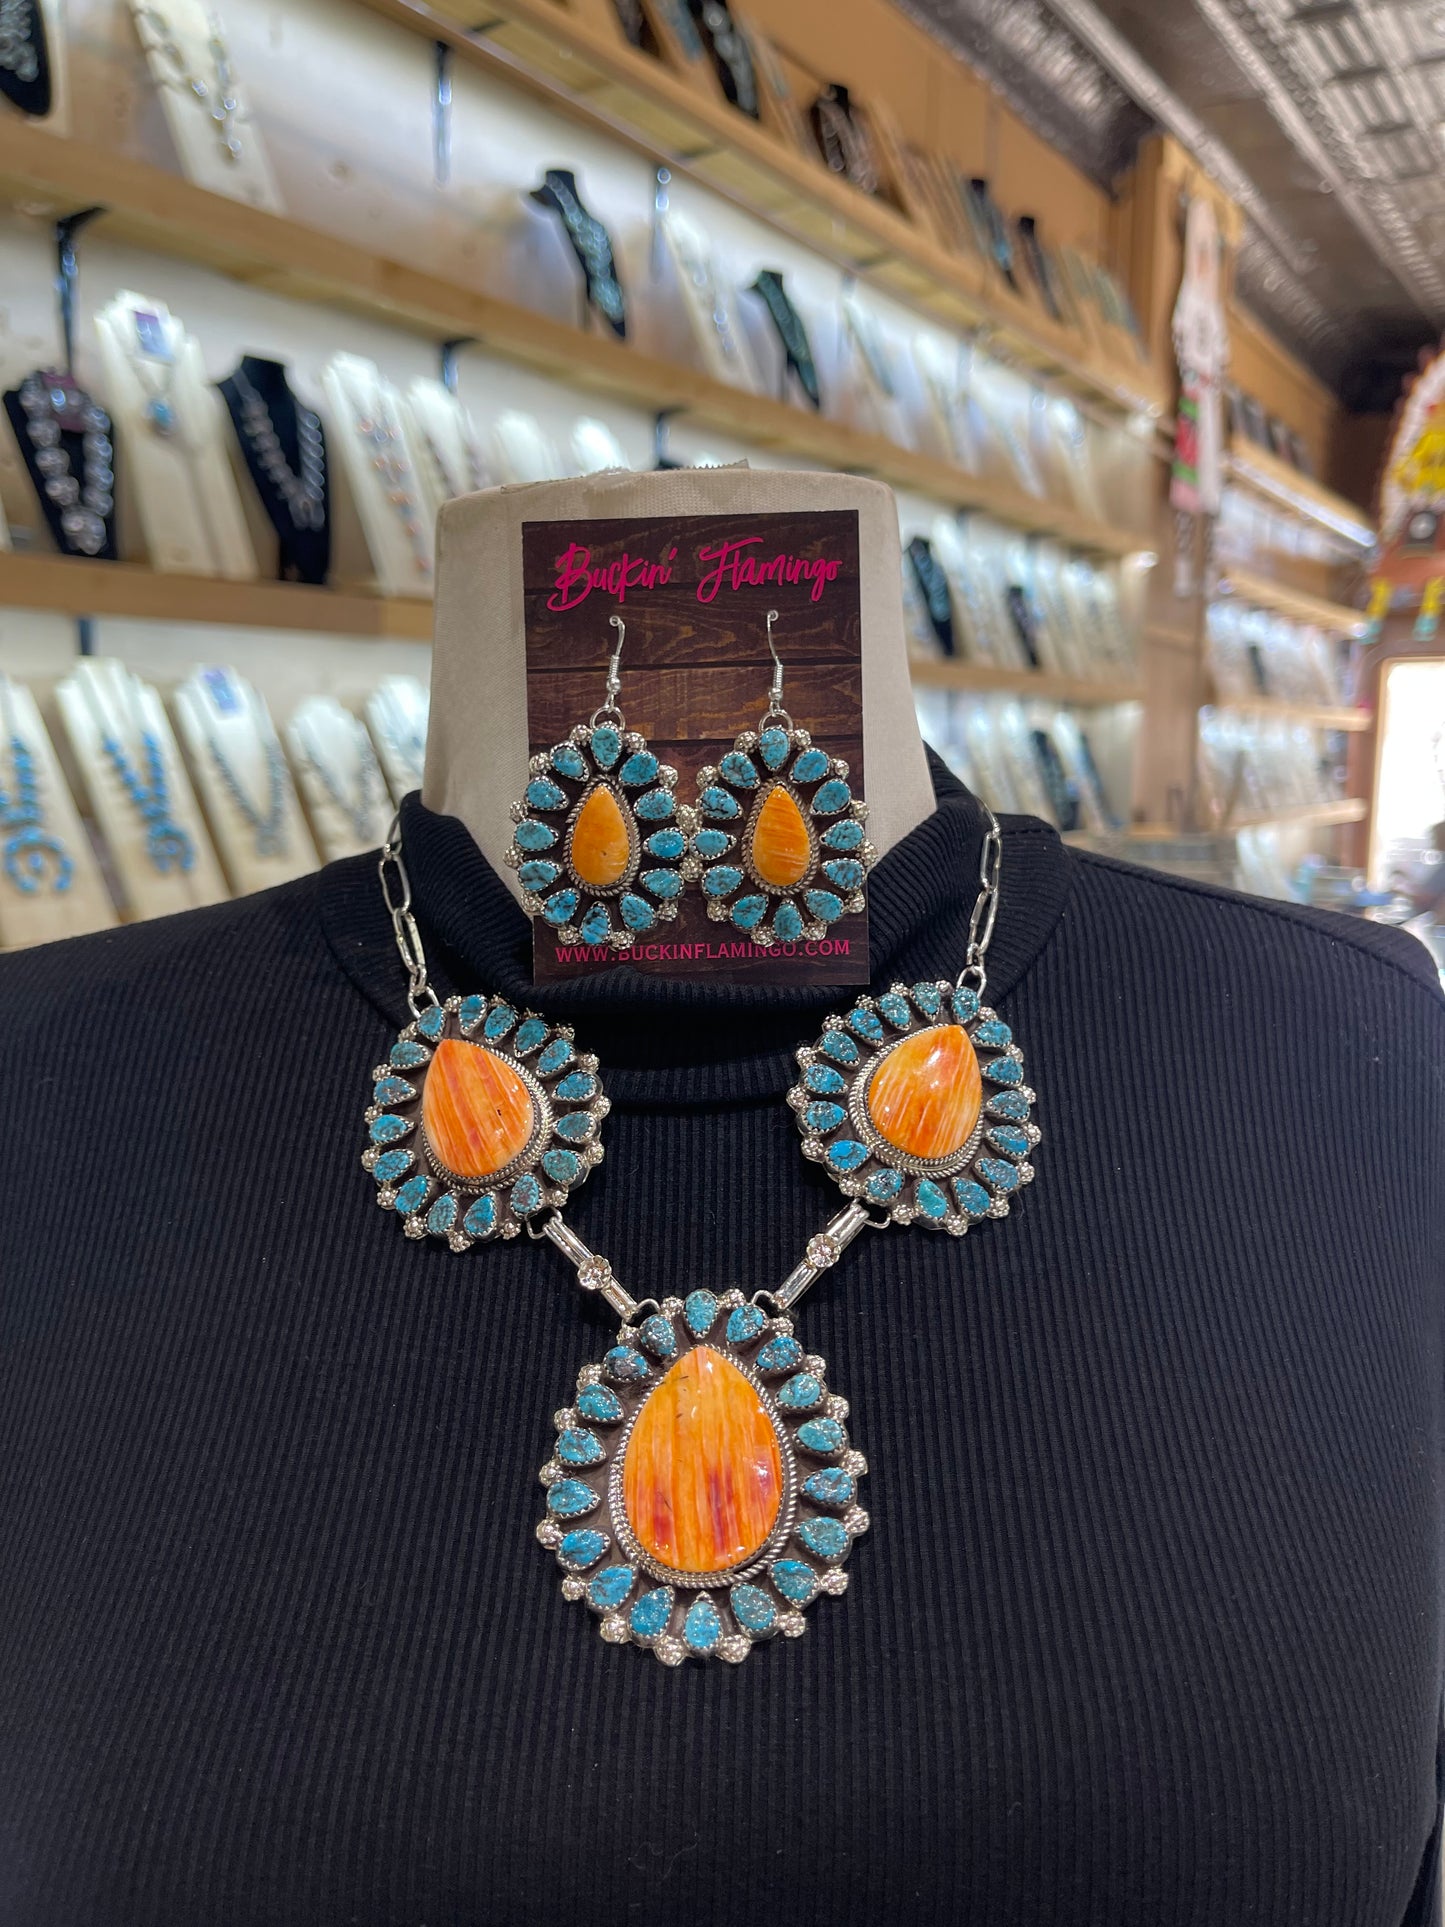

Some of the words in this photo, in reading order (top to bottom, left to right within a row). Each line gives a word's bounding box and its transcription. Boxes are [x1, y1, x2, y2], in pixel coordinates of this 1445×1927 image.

[547, 542, 678, 611] Buckin'
[696, 536, 843, 603] Flamingo
[554, 939, 850, 963] WWW.BUCKINFLAMINGO.COM
